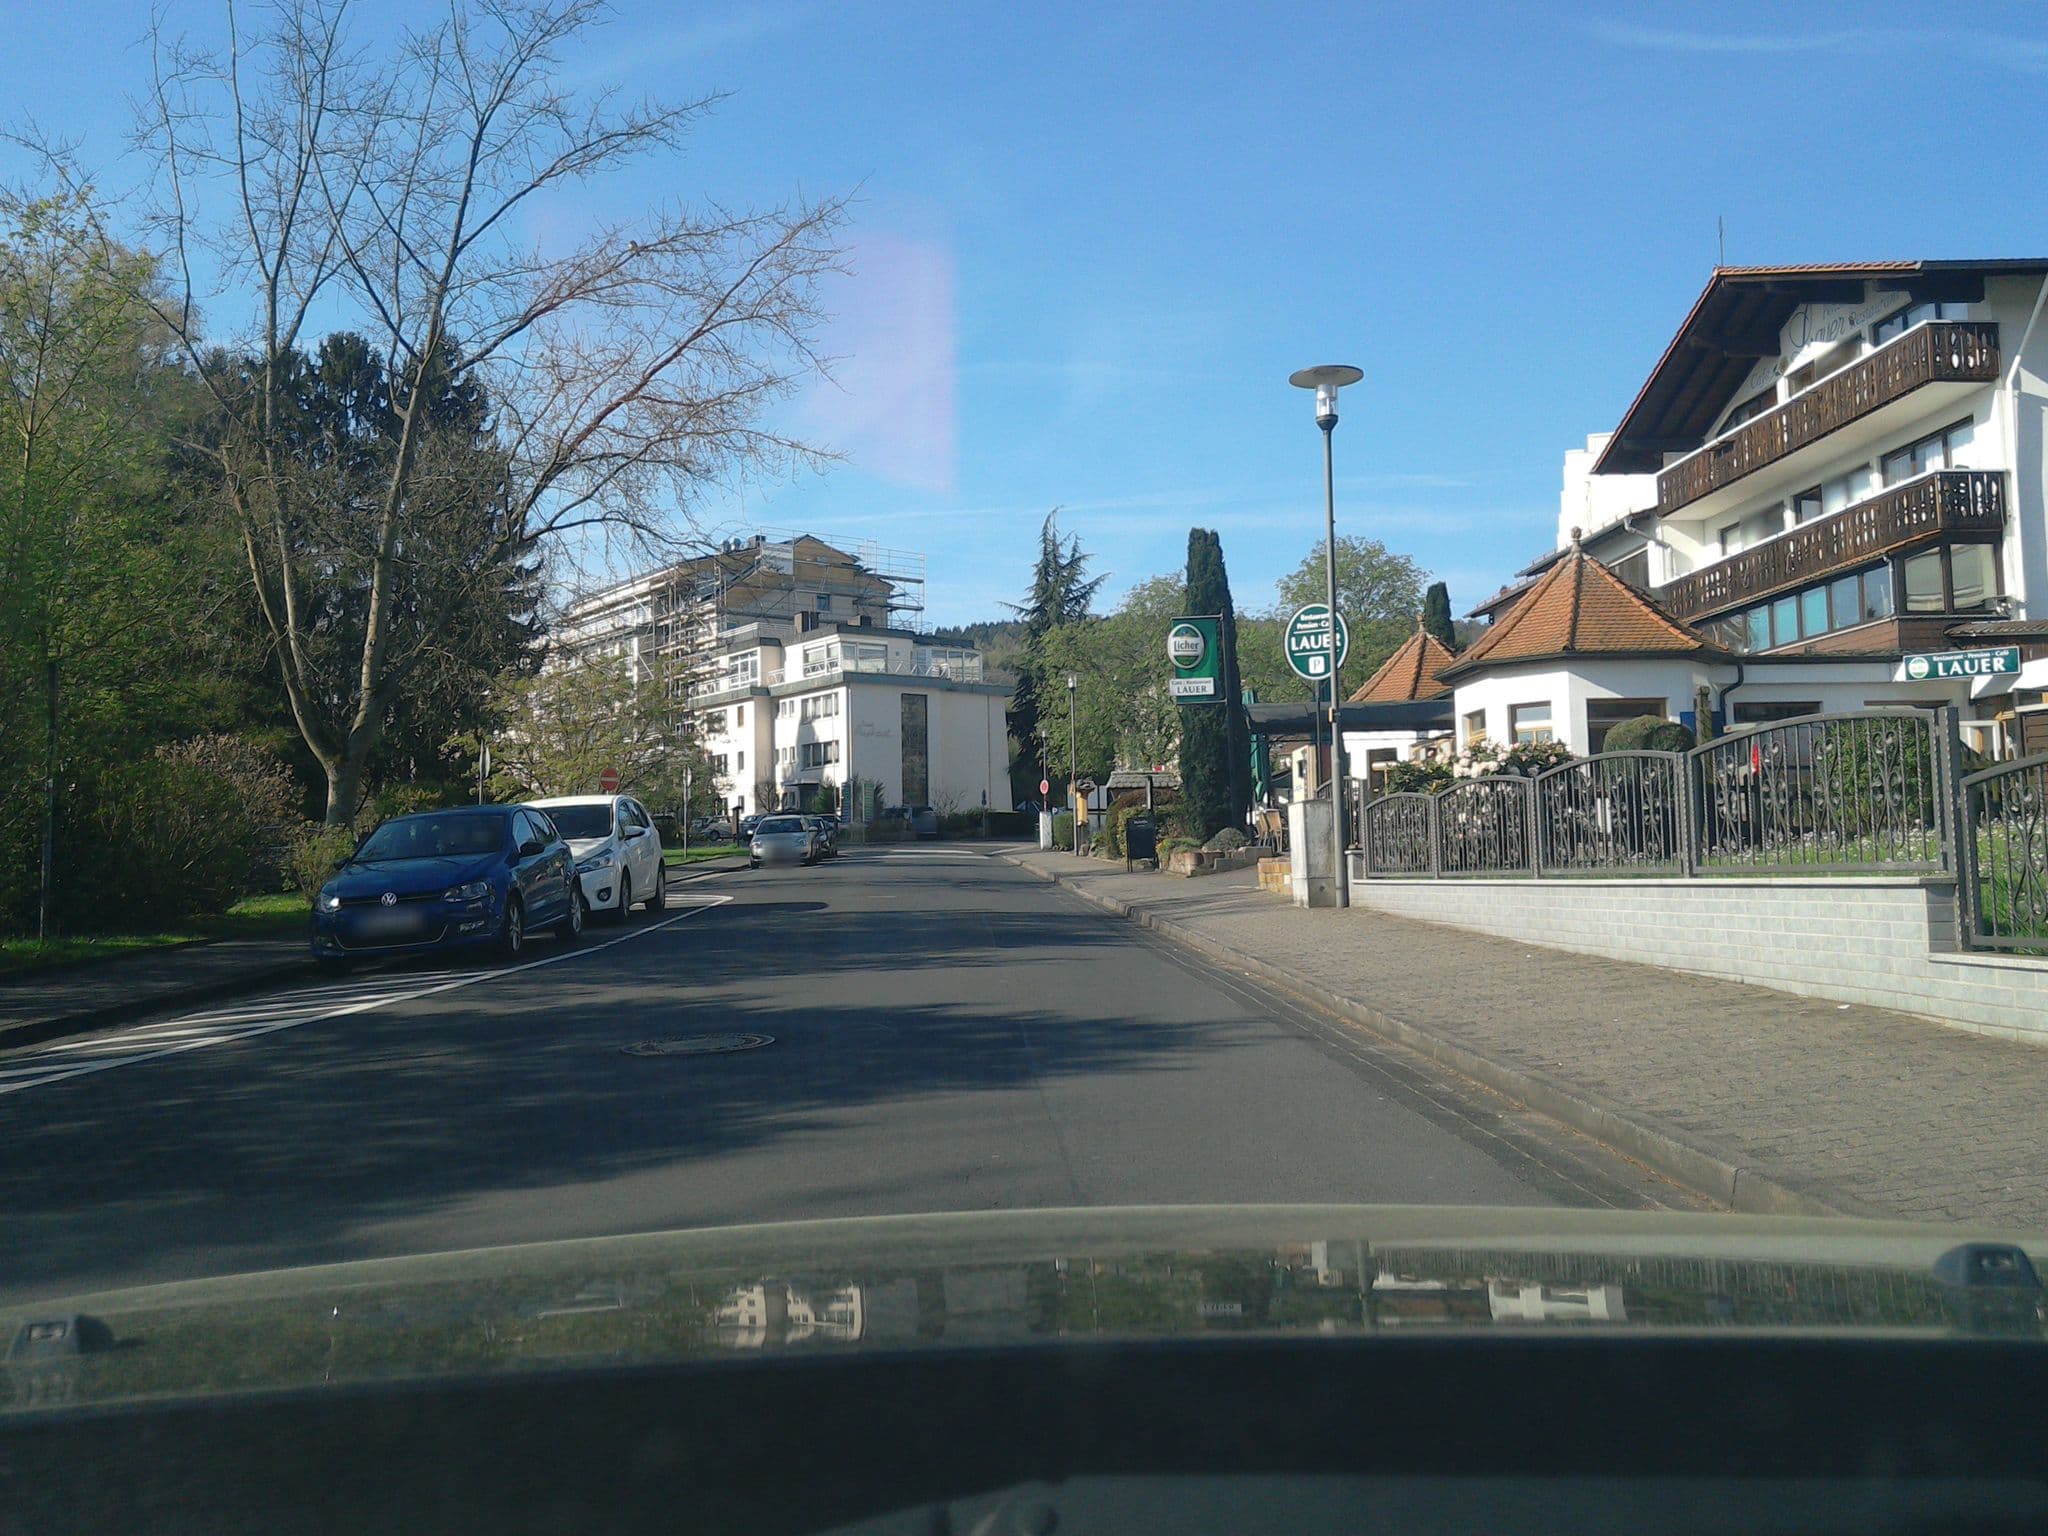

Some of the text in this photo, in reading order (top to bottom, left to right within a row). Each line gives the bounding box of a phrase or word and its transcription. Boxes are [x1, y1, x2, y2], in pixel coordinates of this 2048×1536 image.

[1174, 640, 1199, 652] Licher
[1291, 632, 1341, 651] LAUER
[1938, 657, 2006, 676] LAUER
[1177, 686, 1207, 694] LAUER
